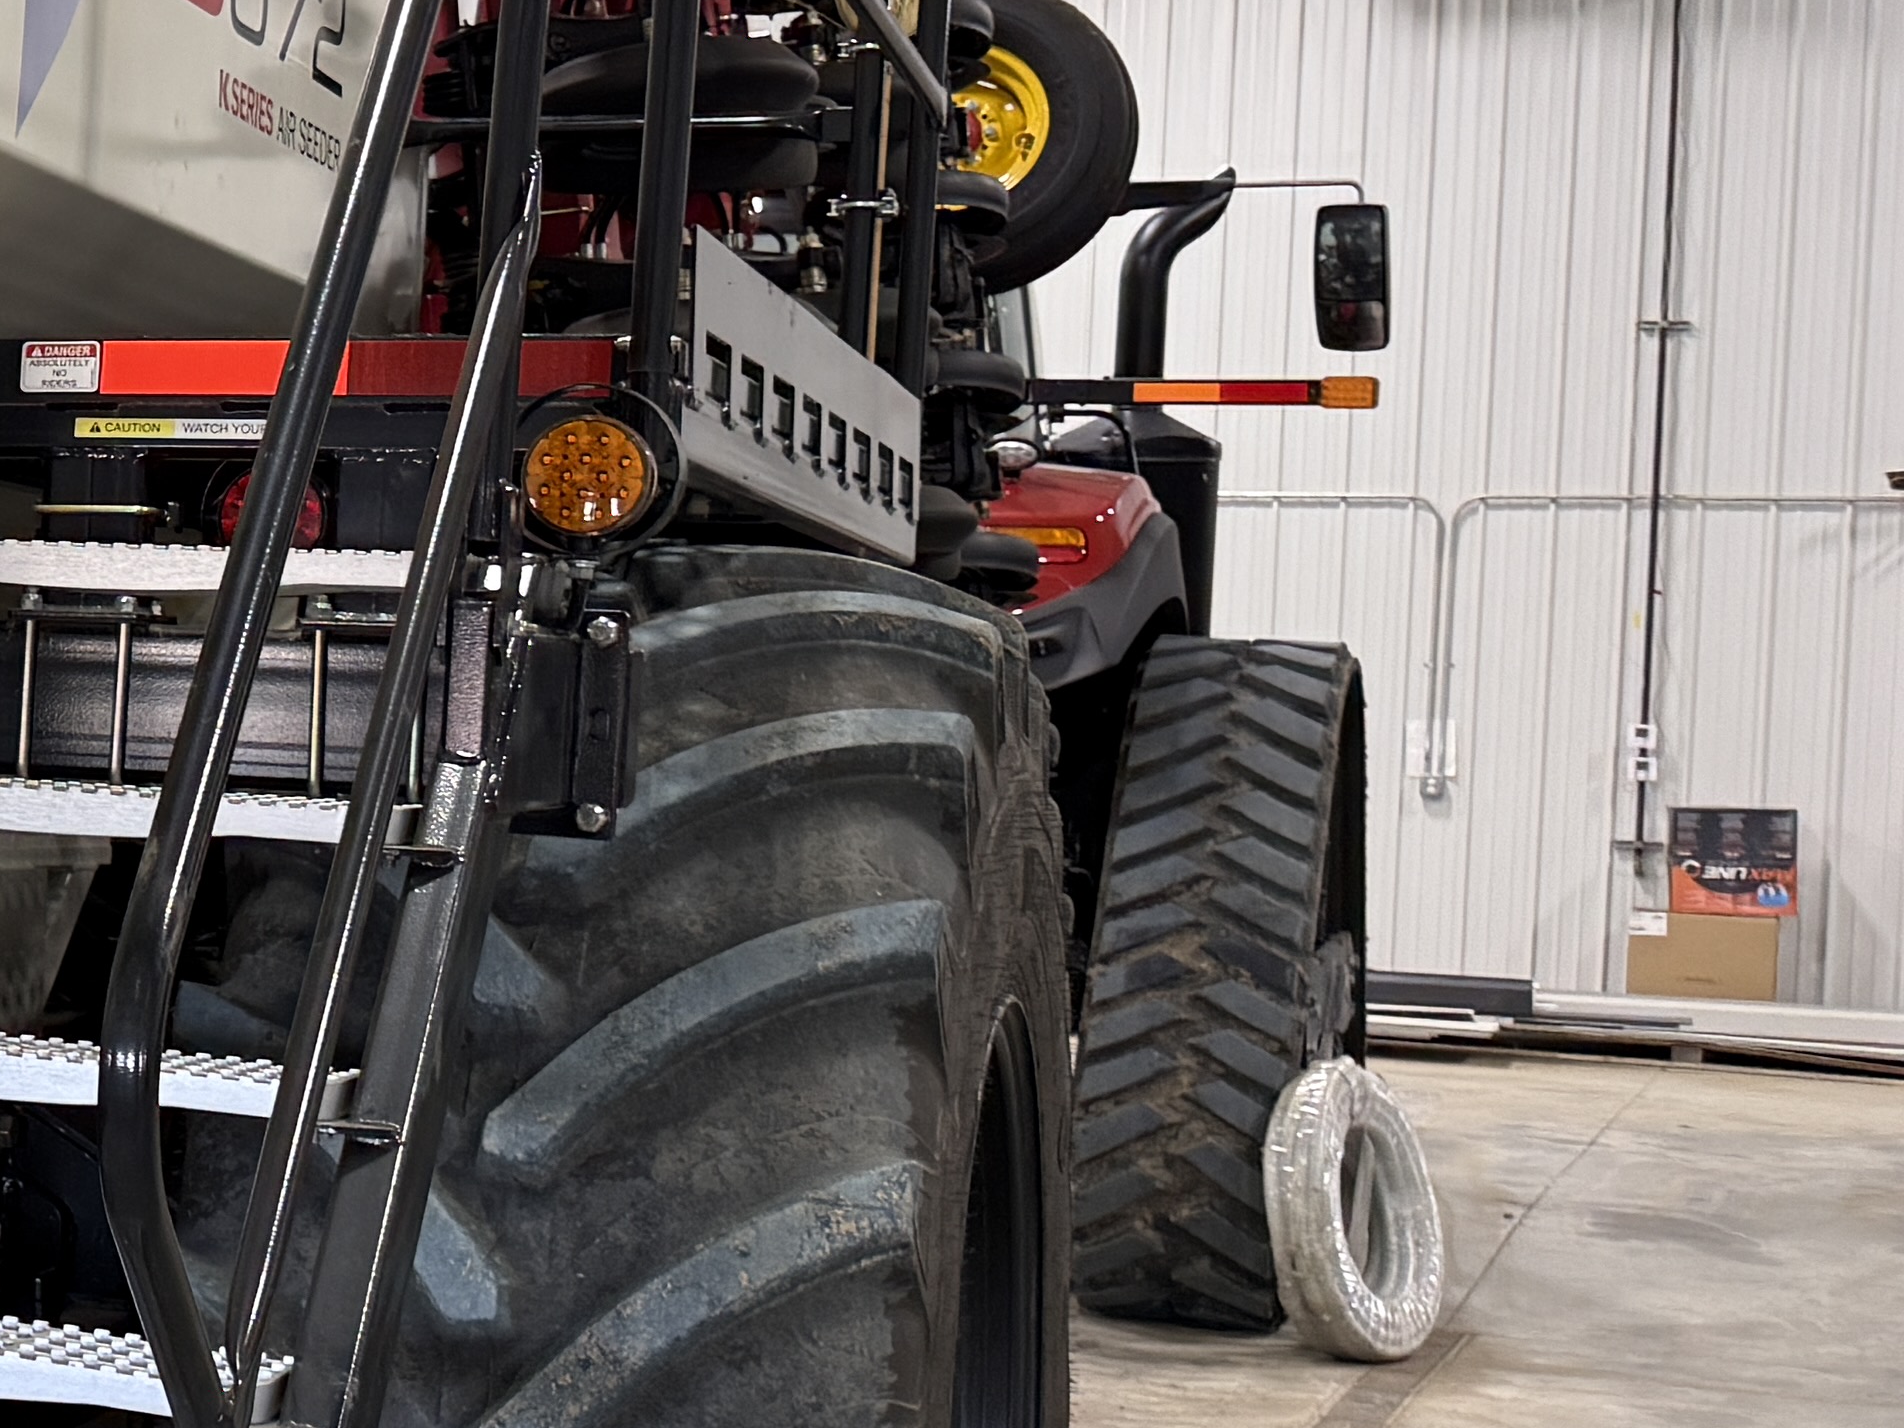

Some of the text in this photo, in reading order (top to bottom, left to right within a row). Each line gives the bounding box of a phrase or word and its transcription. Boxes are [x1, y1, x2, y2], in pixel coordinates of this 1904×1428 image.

[231, 77, 273, 137] SERIES
[276, 106, 296, 150] AIR
[299, 117, 341, 172] SEEDER
[44, 345, 91, 357] DANGER
[29, 359, 90, 367] ABSOLUTELY
[52, 369, 68, 377] NO
[104, 422, 161, 433] CAUTION
[182, 422, 228, 434] WATCH
